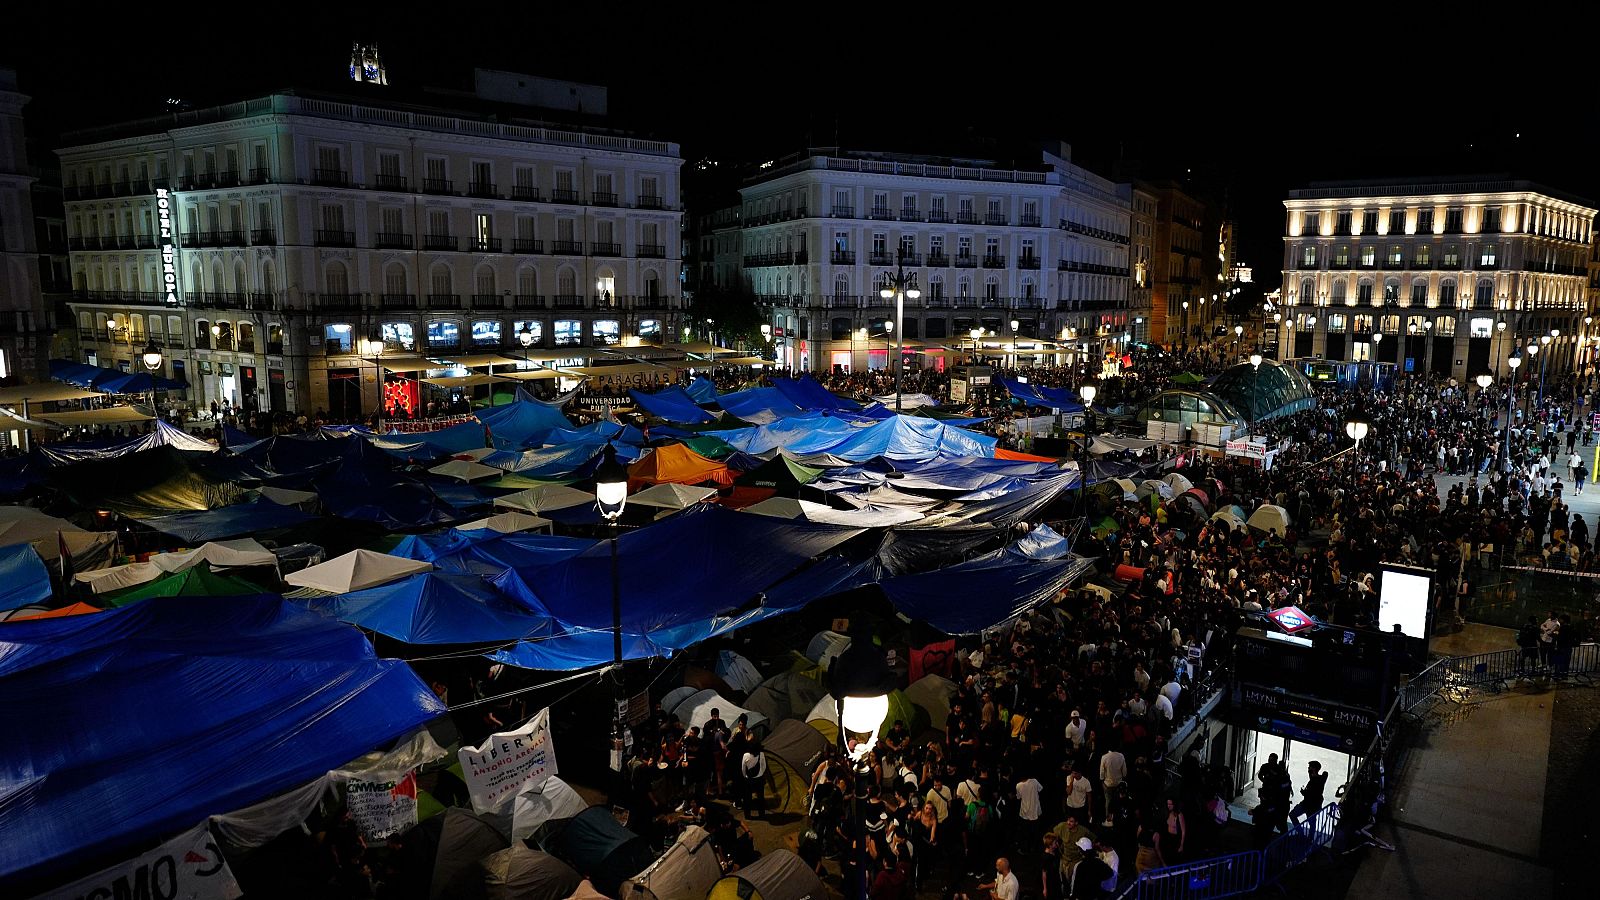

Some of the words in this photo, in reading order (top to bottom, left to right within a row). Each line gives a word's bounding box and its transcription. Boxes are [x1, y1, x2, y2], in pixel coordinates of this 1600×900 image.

[156, 188, 171, 238] HOTEL
[163, 244, 178, 303] EUROPA
[598, 372, 670, 386] PARAGUAS
[580, 397, 631, 405] UNIVERSIDAD
[474, 757, 512, 776] ANTONIO
